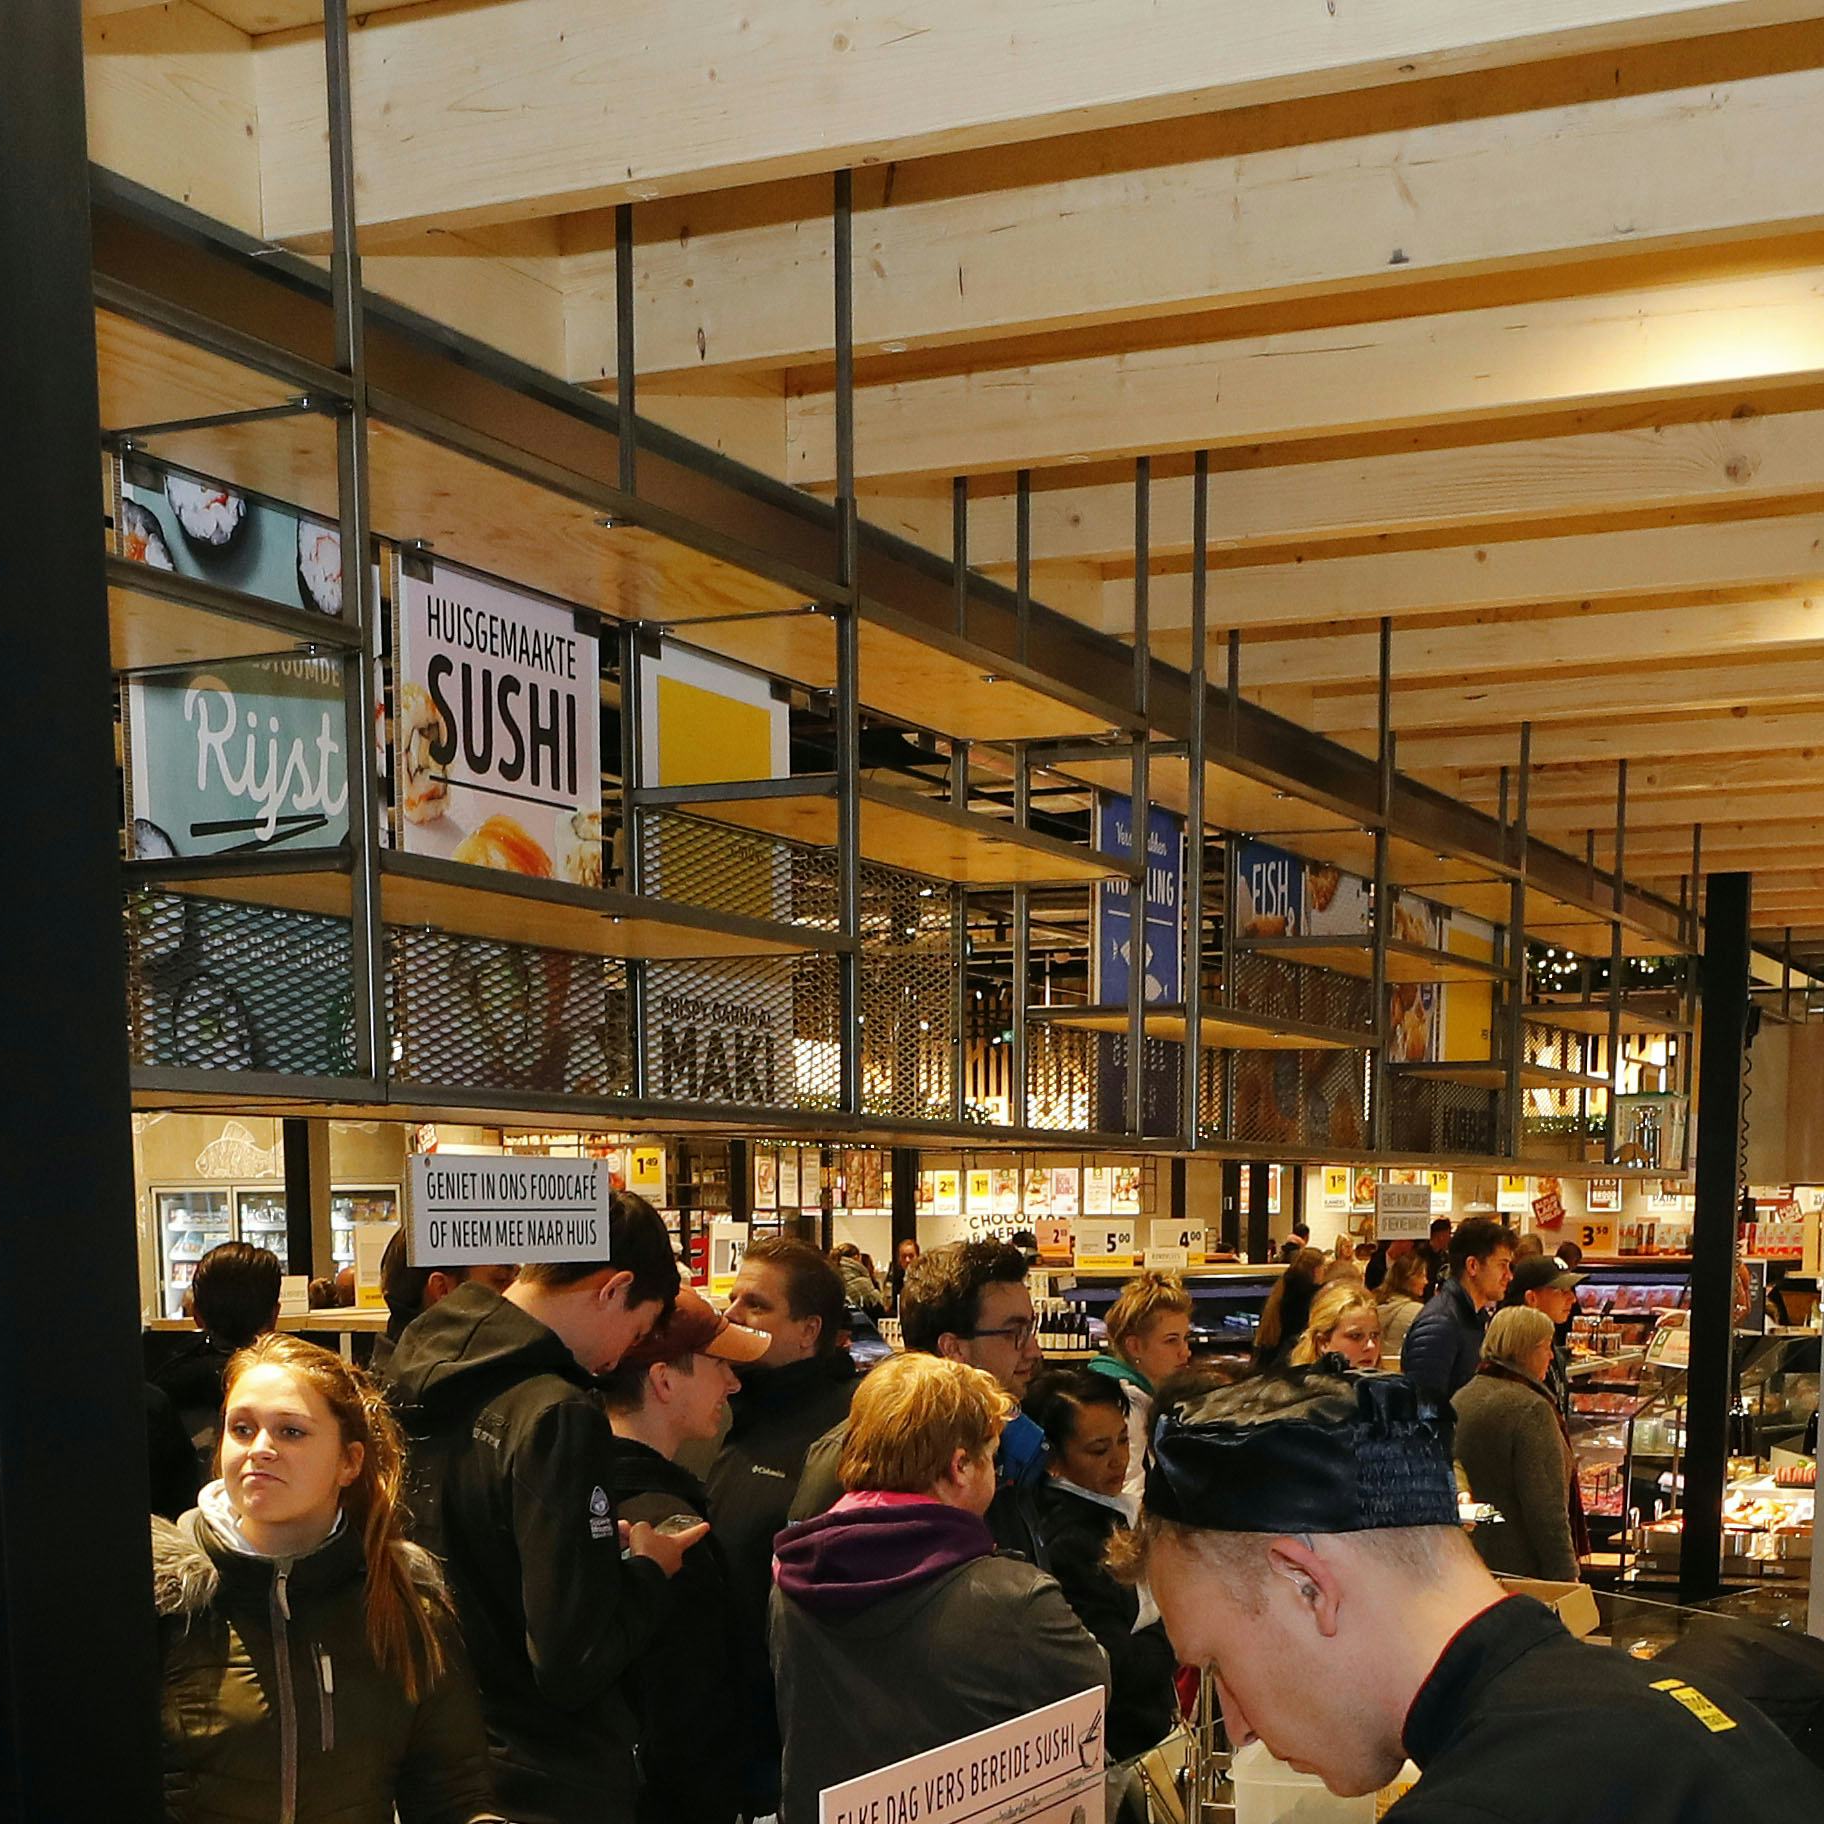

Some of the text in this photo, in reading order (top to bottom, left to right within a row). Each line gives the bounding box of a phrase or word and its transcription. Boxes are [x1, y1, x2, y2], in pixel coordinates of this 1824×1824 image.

[427, 595, 576, 680] HUISGEMAAKTE
[184, 674, 349, 842] Rijst
[428, 653, 578, 796] SUSHI
[1252, 860, 1288, 918] FISH
[427, 1168, 597, 1200] GENIET IN ONS FOODCAFÉ
[430, 1219, 597, 1248] OF NEEM MEE NAAR HUIS
[924, 1766, 966, 1816] VERS
[971, 1740, 1031, 1797] BEREIDE
[1035, 1722, 1076, 1769] SUSHI
